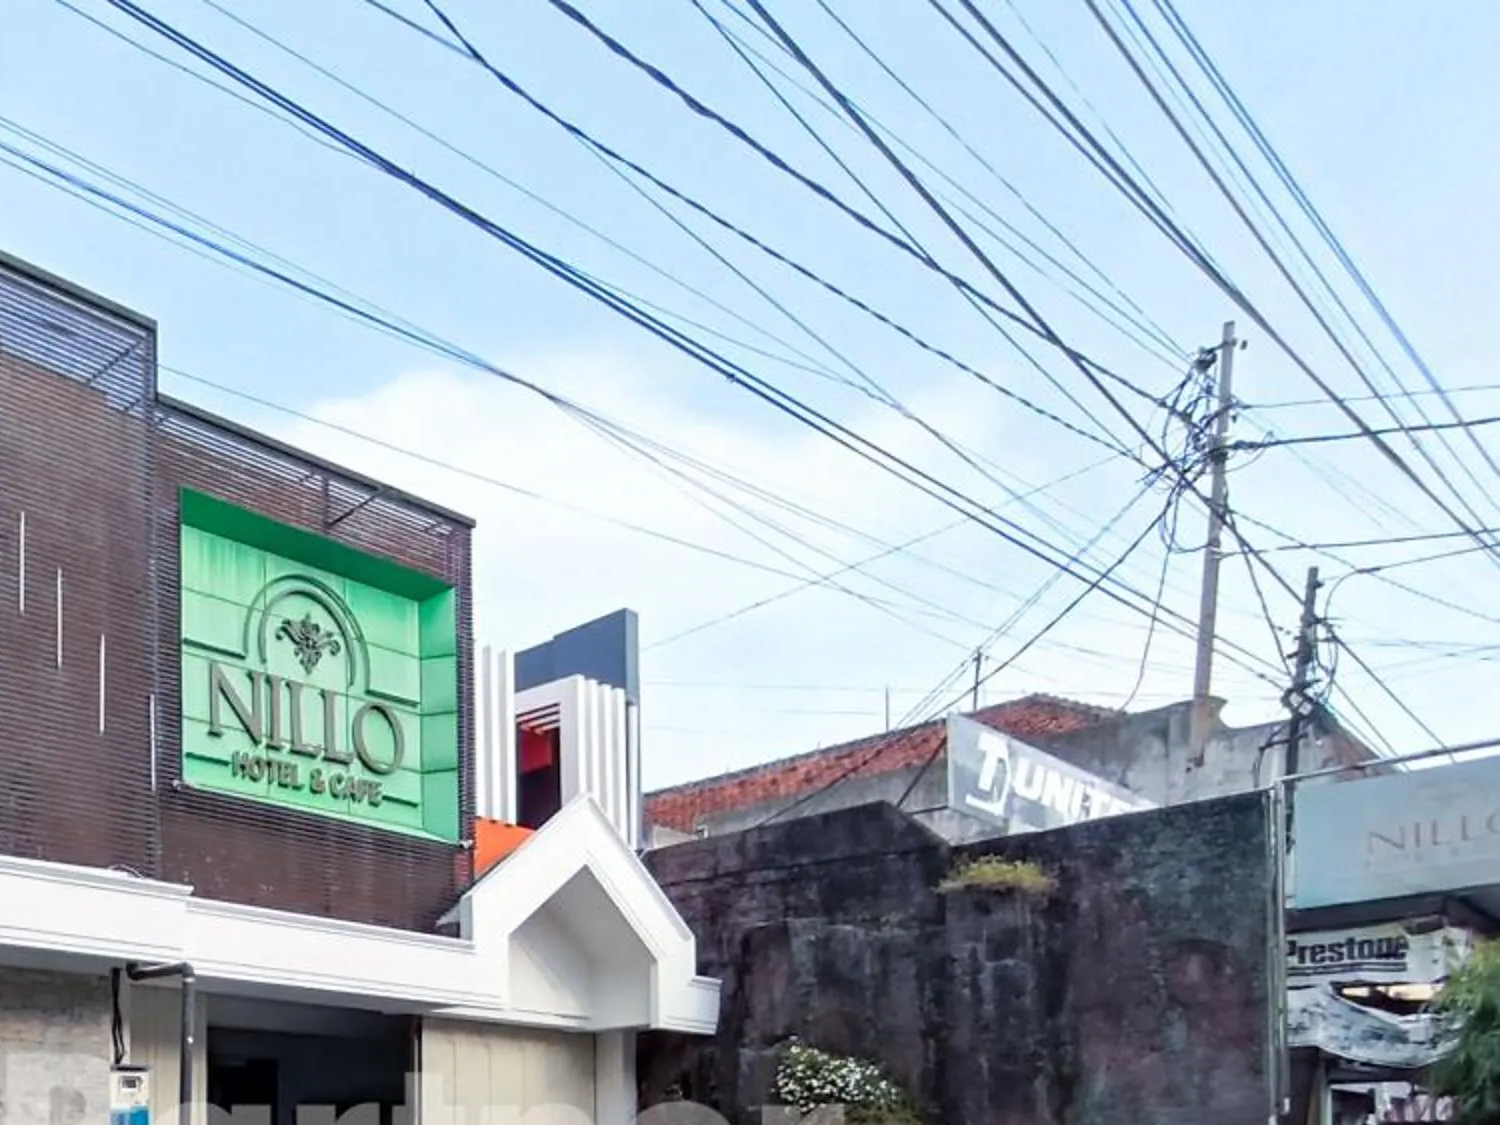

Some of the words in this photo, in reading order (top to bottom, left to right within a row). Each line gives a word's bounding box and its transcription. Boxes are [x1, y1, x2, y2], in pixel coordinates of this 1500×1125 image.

[208, 662, 405, 776] NILLO
[231, 750, 305, 791] HOTEL
[310, 768, 326, 794] &
